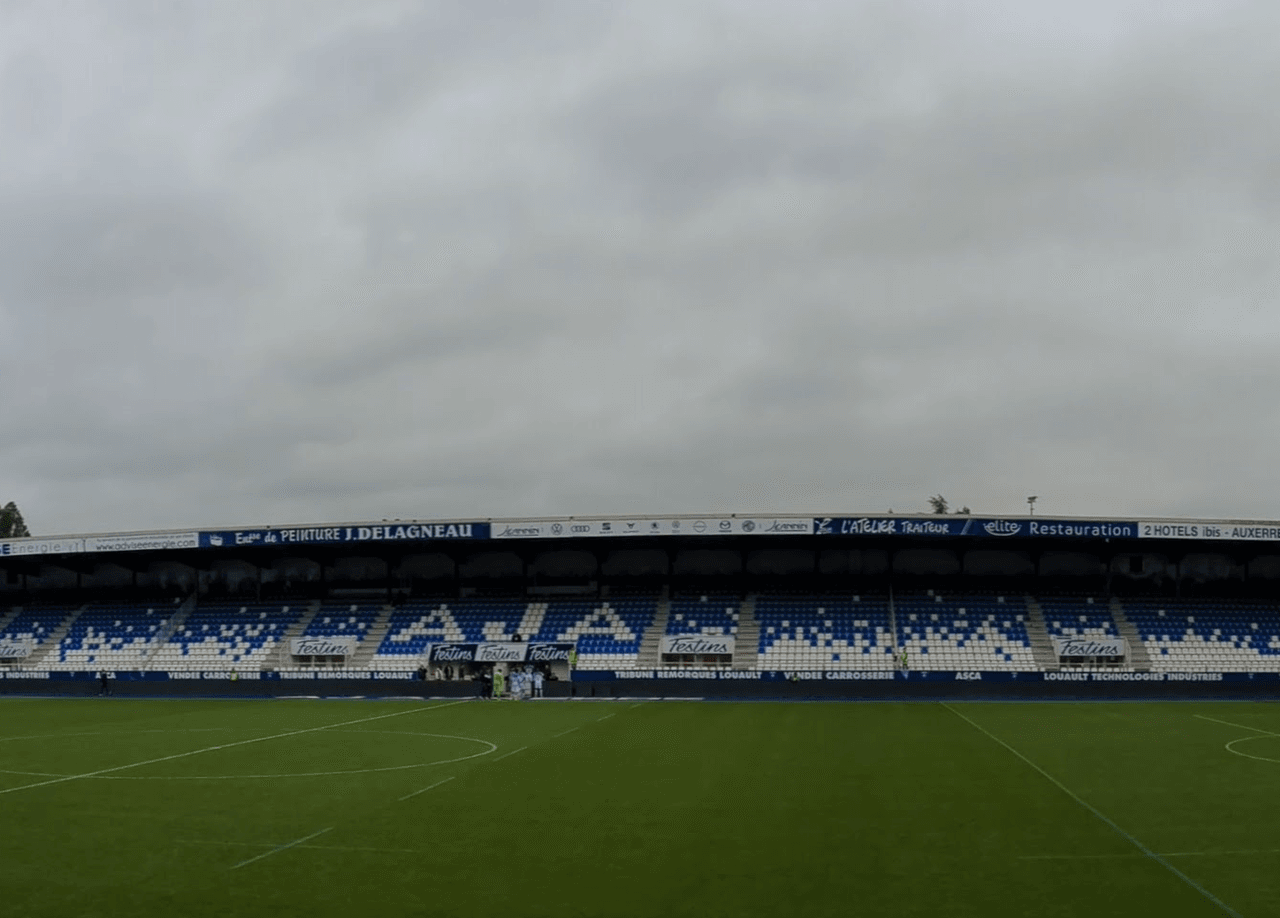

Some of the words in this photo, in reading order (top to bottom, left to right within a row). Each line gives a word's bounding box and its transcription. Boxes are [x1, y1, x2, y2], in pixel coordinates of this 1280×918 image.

[841, 519, 896, 534] L'ATELIER
[901, 521, 949, 534] TRAITEUR
[1030, 522, 1130, 536] Restauration
[1144, 526, 1151, 535] 2
[1154, 525, 1198, 537] HOTELS
[1202, 526, 1220, 537] ibis
[264, 531, 277, 543] de
[280, 528, 341, 542] PEINTURE
[668, 637, 727, 652] Festins
[1061, 640, 1119, 654] Festins
[433, 645, 473, 660] Festins
[479, 645, 521, 660] Festins
[529, 644, 569, 660] Festins
[615, 671, 654, 679] TRIBUNE
[657, 671, 717, 679] REMORQUES
[719, 671, 762, 679] LOUAULT
[826, 672, 895, 680] CARROSSERIE
[955, 672, 982, 680] ASCA
[1044, 672, 1088, 680] LOUAULT
[1168, 673, 1223, 681] INDUSTRIES
